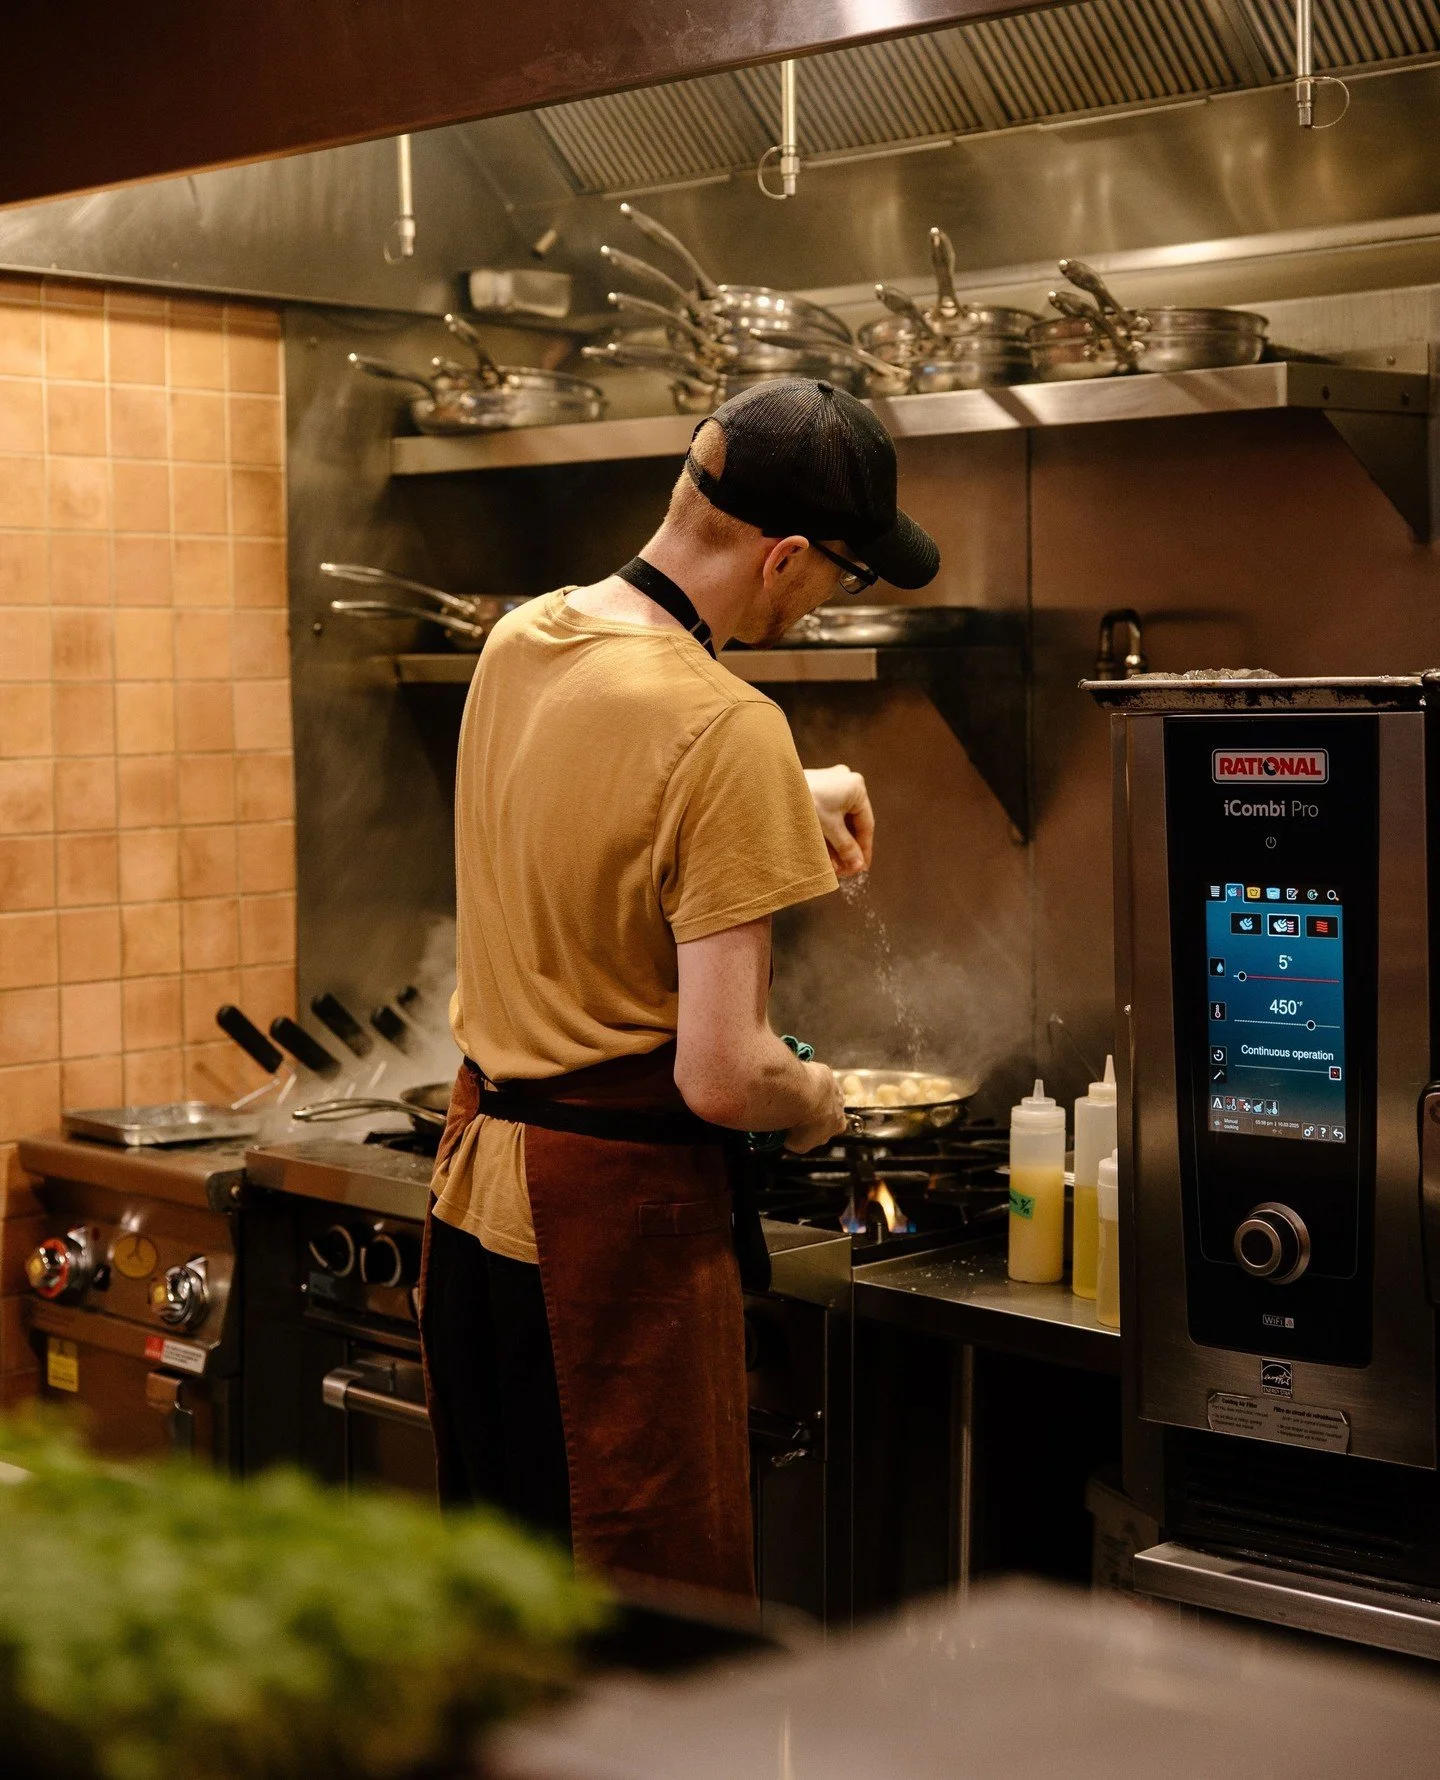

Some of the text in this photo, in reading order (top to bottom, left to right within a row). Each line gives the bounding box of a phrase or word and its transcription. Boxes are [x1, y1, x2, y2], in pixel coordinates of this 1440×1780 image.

[1219, 756, 1322, 776] RATIONAL
[1223, 800, 1319, 817] iCombi Pro
[1241, 1044, 1334, 1061] Continuous operation
